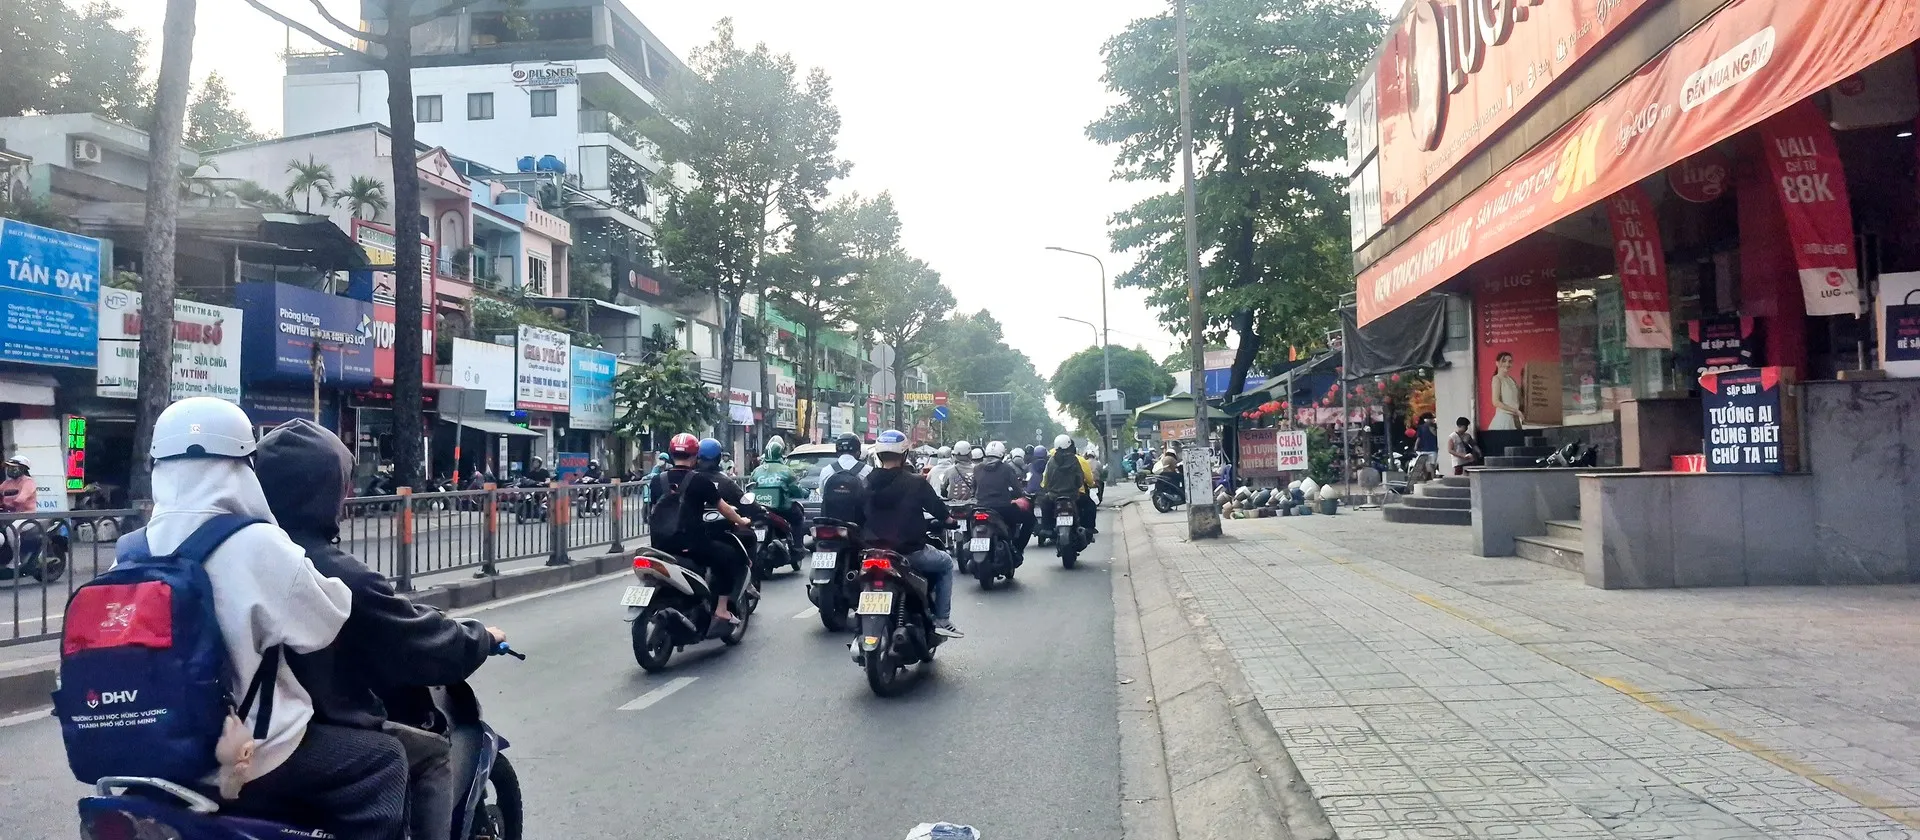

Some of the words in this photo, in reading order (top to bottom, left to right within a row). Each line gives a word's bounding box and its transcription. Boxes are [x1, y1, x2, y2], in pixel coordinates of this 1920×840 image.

[529, 68, 574, 78] PILSNER
[1686, 77, 1706, 104] ĐẾN
[1708, 66, 1729, 91] MUA
[1732, 41, 1768, 78] NGAY!
[1776, 136, 1817, 158] VALI
[1511, 175, 1537, 208] HOT
[1552, 115, 1608, 203] 9K
[1782, 173, 1835, 203] 88K
[1375, 271, 1392, 302] NEW
[1392, 251, 1420, 293] TOUCH
[1421, 231, 1448, 277] NEW
[1448, 216, 1473, 261] LUG
[1618, 239, 1657, 276] 2H
[55, 269, 93, 296] ĐẠT
[106, 295, 128, 307] HTS
[1821, 289, 1841, 298] LUG
[197, 307, 207, 316] TM
[279, 308, 301, 320] Phòng
[280, 322, 309, 338] CHUYÊN
[116, 347, 134, 359] LINH
[189, 367, 208, 380] TÍNH
[1726, 385, 1741, 397] SẬP
[1741, 384, 1757, 395] SÀN
[1709, 401, 1754, 425] TƯỞNG
[1758, 405, 1772, 423] AI
[1711, 424, 1747, 445] CŨNG
[1751, 422, 1779, 443] BIẾT
[1712, 444, 1740, 464] CHỨ
[1743, 446, 1761, 464] TA
[1764, 446, 1778, 463] !!!
[757, 475, 781, 485] Grab
[102, 689, 139, 705] DHV
[120, 711, 140, 719] HÙNG
[140, 708, 168, 717] VƯƠNG
[137, 717, 157, 725] MINH
